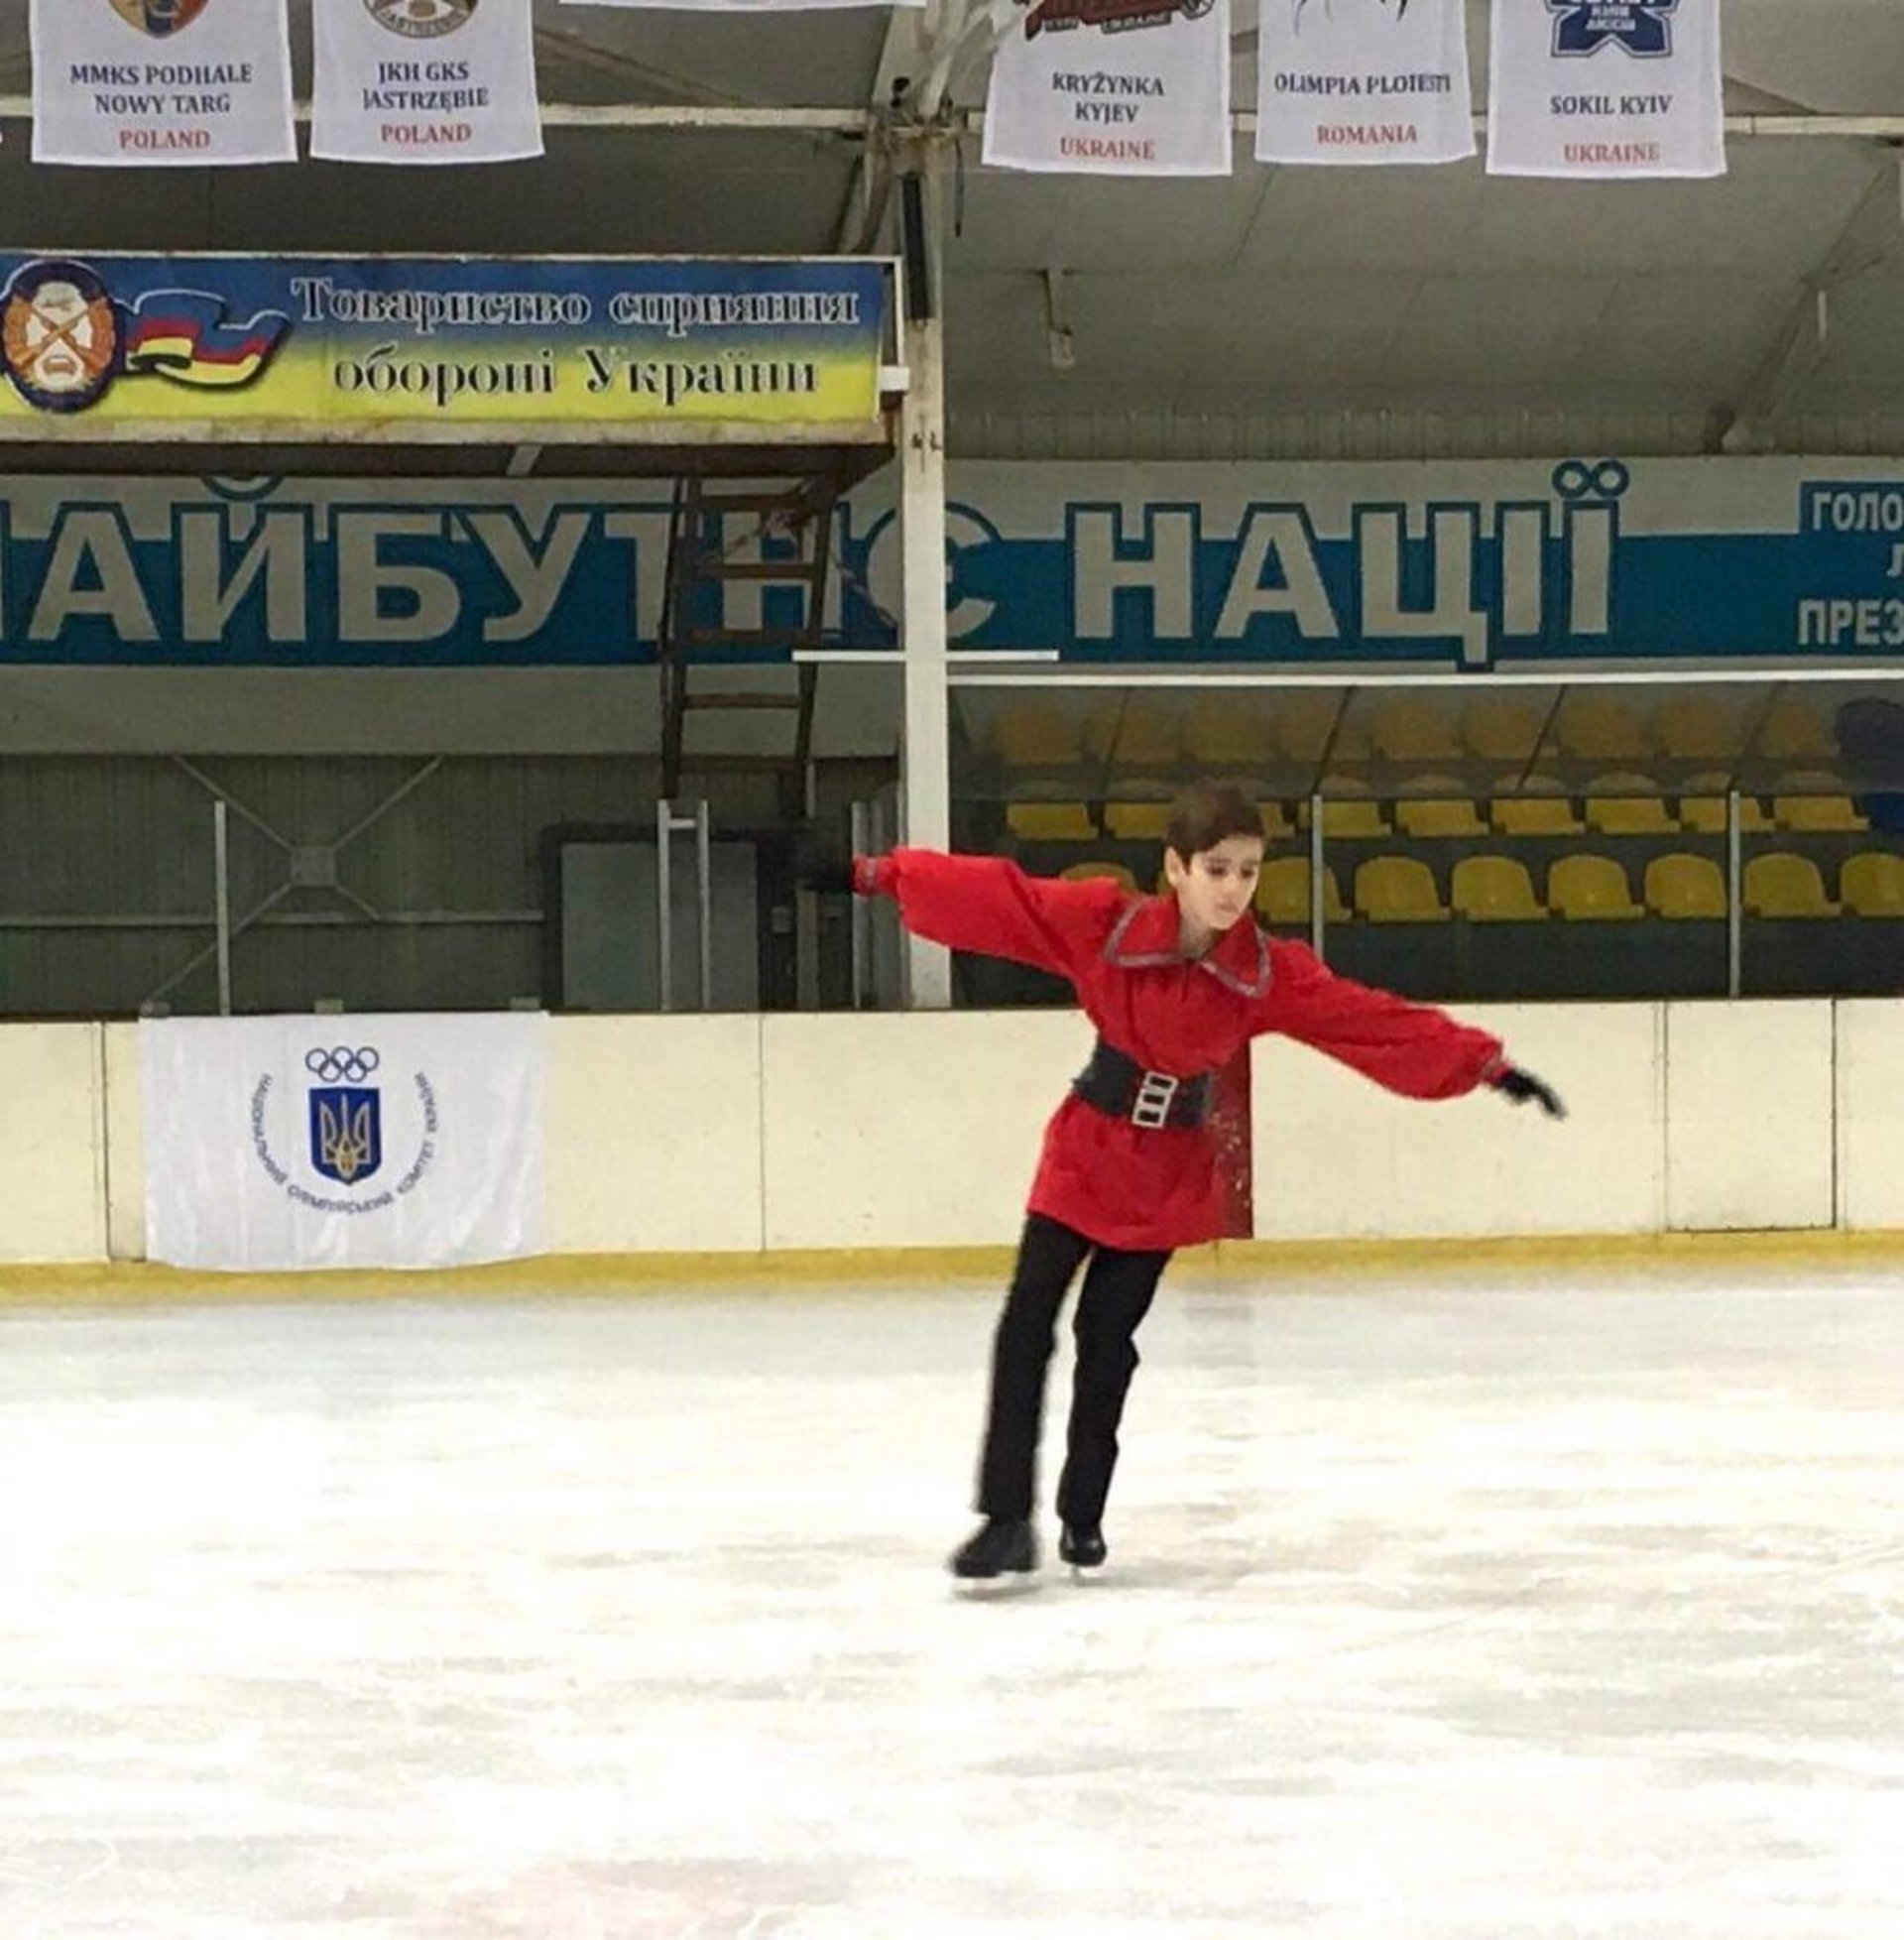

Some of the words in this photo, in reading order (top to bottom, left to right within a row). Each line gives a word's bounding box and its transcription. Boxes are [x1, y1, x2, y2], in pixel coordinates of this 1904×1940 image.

[70, 64, 139, 84] MMKS
[146, 62, 252, 85] PODHALE
[379, 61, 419, 84] JKH
[425, 61, 469, 81] GKS
[1052, 70, 1164, 97] KRYŽYNKA
[1274, 72, 1361, 95] OLIMPIA
[95, 93, 166, 114] NOWY
[172, 93, 231, 113] TARG
[363, 87, 489, 113] JASTRZĘBIE
[1550, 95, 1614, 115] SOKIL
[1620, 94, 1673, 114] KYIV
[1075, 100, 1138, 124] KYJEV
[119, 130, 211, 149] POLAND
[381, 124, 472, 143] POLAND
[1317, 125, 1418, 144] ROMANIA
[1060, 137, 1155, 160] UKRAINE
[1564, 143, 1660, 163] UKRAINE
[291, 277, 592, 335] Товариство
[609, 292, 860, 338] сприяння
[333, 341, 553, 406] обороні
[579, 346, 817, 406] України
[0, 477, 998, 643] АЙБУТНЄ
[1068, 461, 1622, 668] НАЦІЇ
